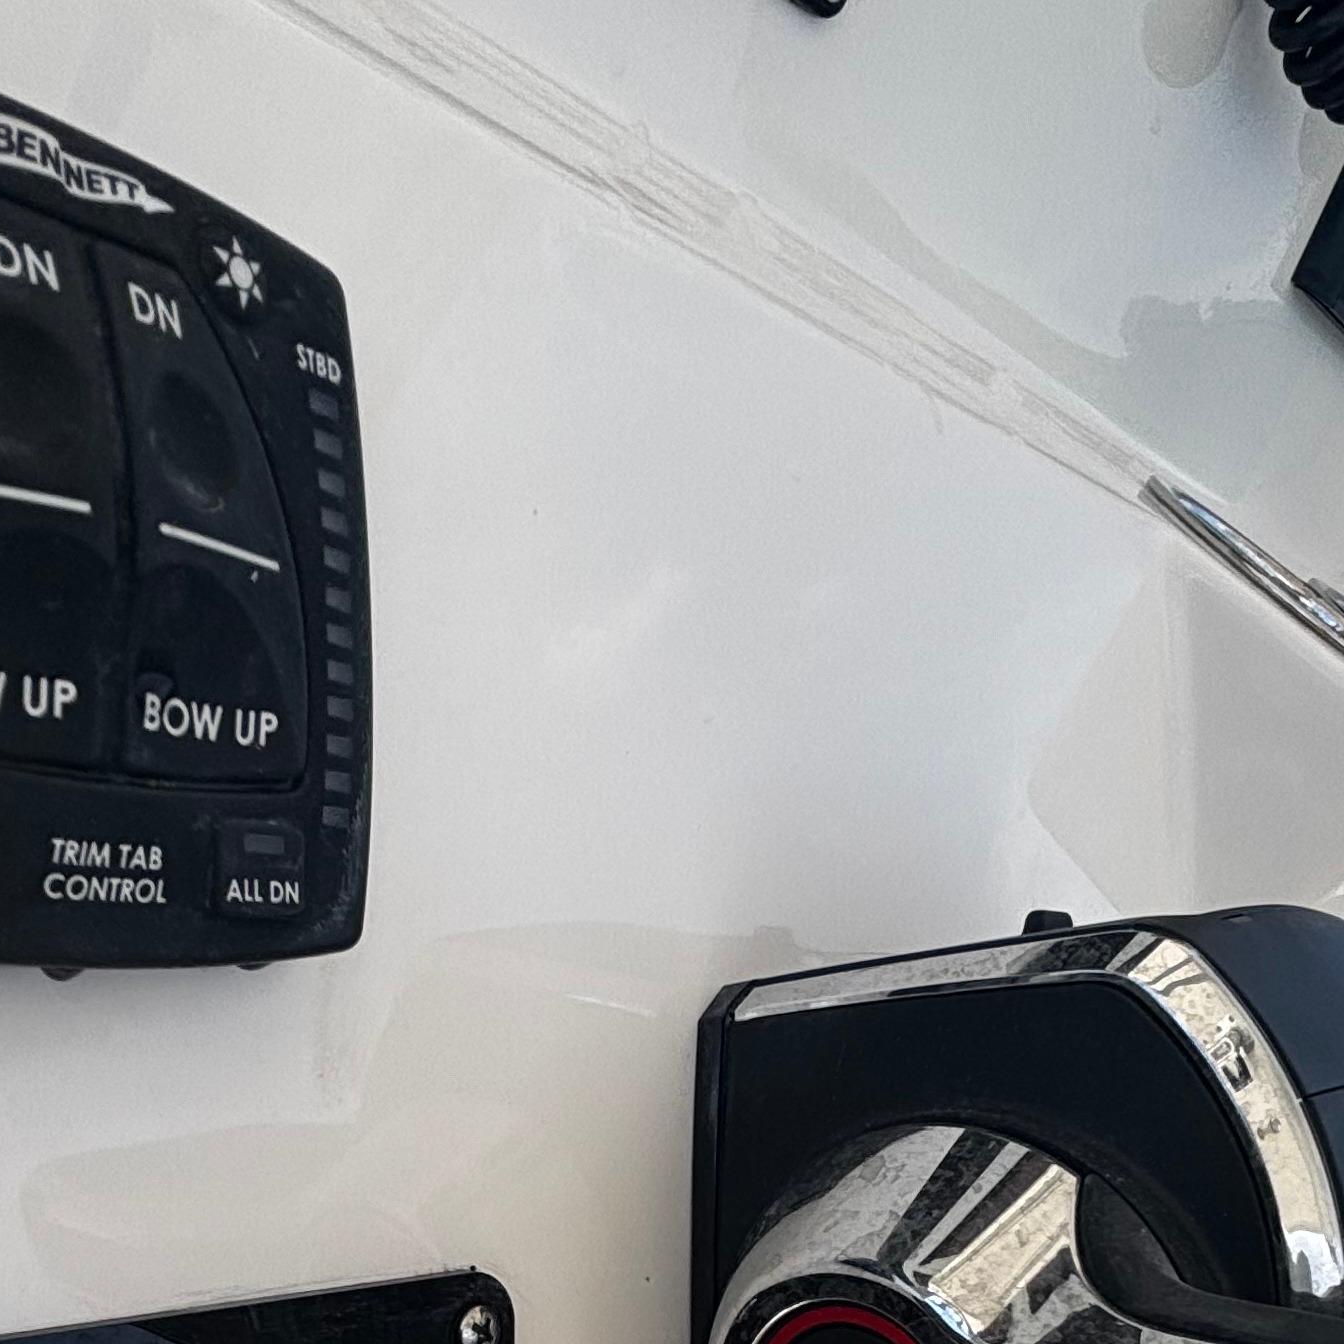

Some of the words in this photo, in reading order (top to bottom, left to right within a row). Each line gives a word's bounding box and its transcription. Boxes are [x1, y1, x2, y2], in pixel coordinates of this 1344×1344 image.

[130, 282, 183, 340] DN
[296, 342, 342, 385] STBD
[23, 676, 78, 719] UP
[144, 692, 222, 745] BOW
[233, 708, 279, 747] UP
[51, 838, 114, 870] TRIM
[119, 844, 163, 871] TAB
[44, 872, 167, 905] CONTROL
[226, 878, 262, 904] ALL
[268, 881, 299, 905] DN
